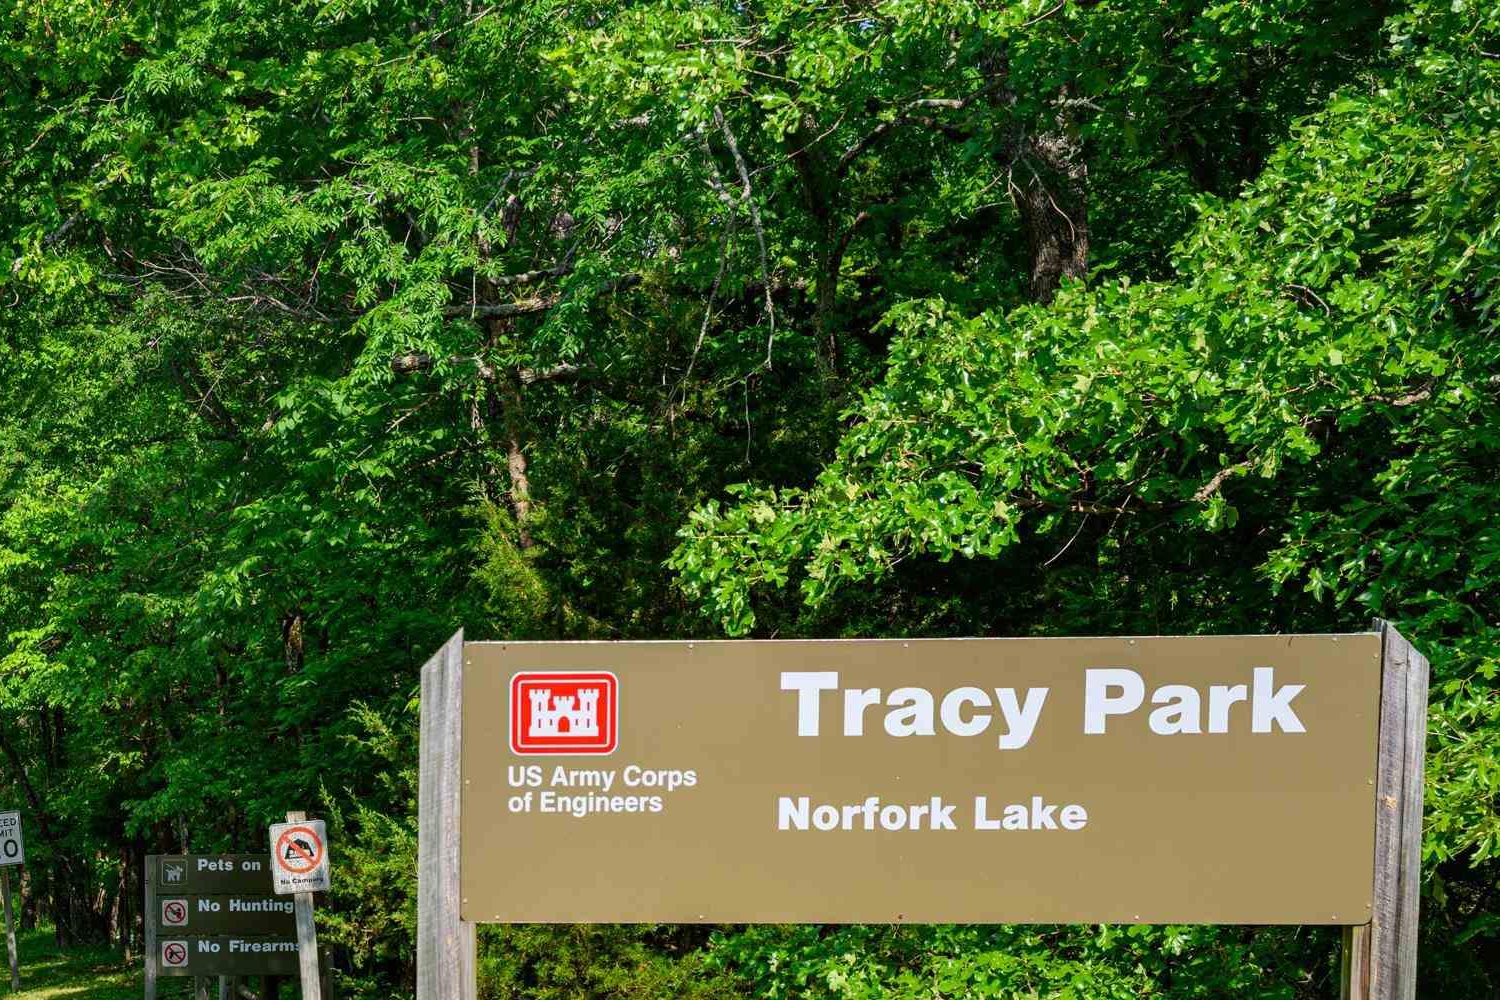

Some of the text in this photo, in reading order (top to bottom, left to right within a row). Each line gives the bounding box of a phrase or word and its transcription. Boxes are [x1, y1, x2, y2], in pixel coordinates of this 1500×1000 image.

[780, 667, 1307, 750] Tracy Park
[508, 765, 697, 792] US Army Corps
[508, 791, 663, 817] of Engineers
[778, 796, 1088, 830] Norfork Lake
[197, 858, 234, 871] Pets
[242, 860, 261, 871] on
[198, 899, 294, 914] No Hunting
[198, 940, 221, 953] No
